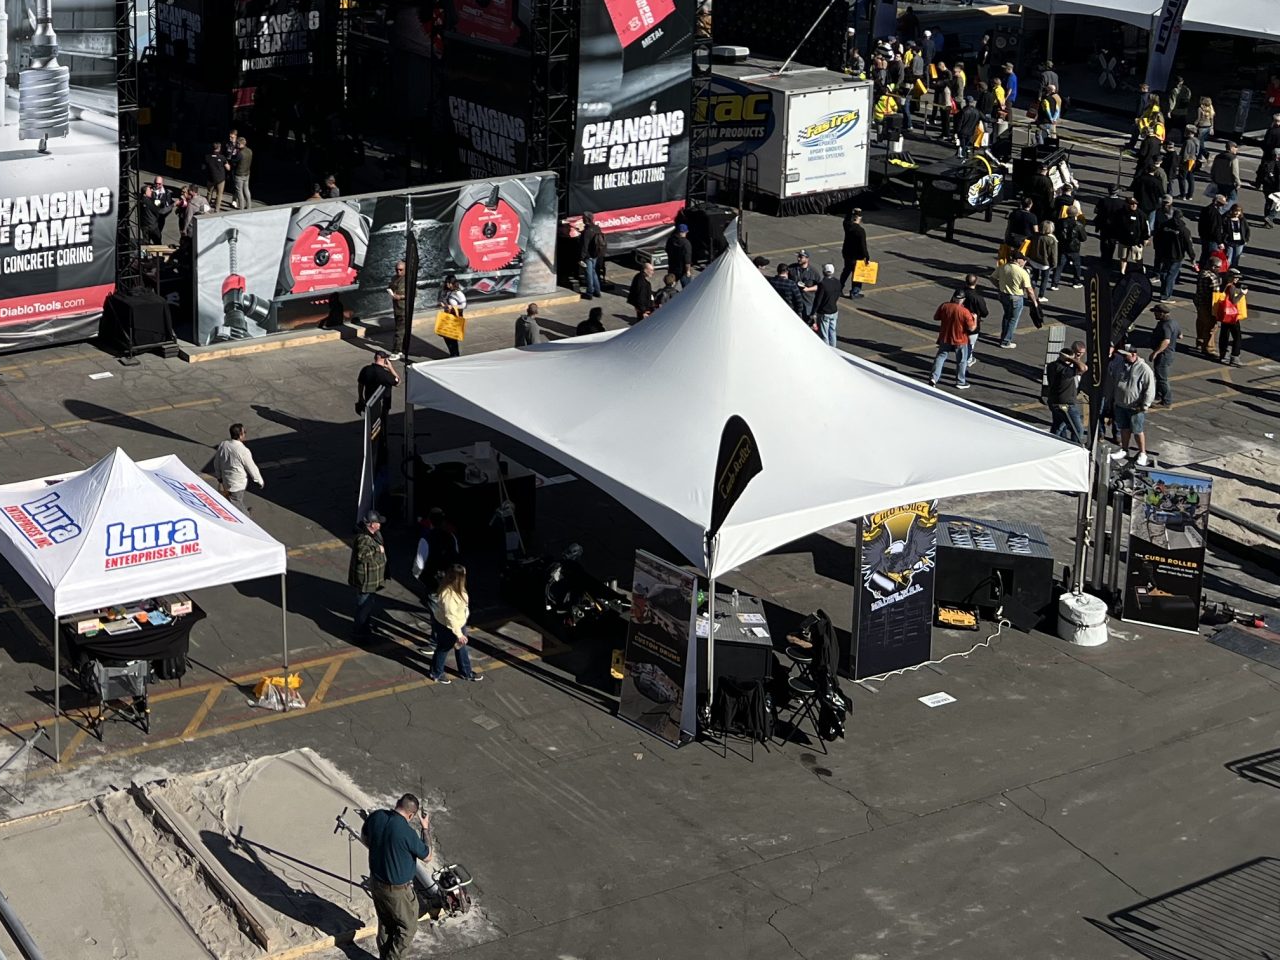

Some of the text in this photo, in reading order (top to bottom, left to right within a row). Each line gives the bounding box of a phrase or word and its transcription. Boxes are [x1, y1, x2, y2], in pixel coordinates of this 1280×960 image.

[641, 28, 664, 48] METAL
[448, 95, 527, 143] CHANGING
[581, 109, 685, 149] CHANGING
[721, 126, 765, 138] PRODUCTS
[470, 126, 517, 165] GAME
[583, 137, 670, 170] THE GAME
[593, 166, 666, 191] IN METAL CUTTING
[14, 215, 91, 252] GAME
[3, 250, 55, 275] CONCRETE
[56, 245, 94, 267] CORING
[0, 297, 85, 319] DiabloTools.com
[21, 491, 82, 544] Lura
[105, 517, 199, 557] Lura
[1144, 554, 1166, 563] CURB
[1167, 558, 1198, 568] ROLLER
